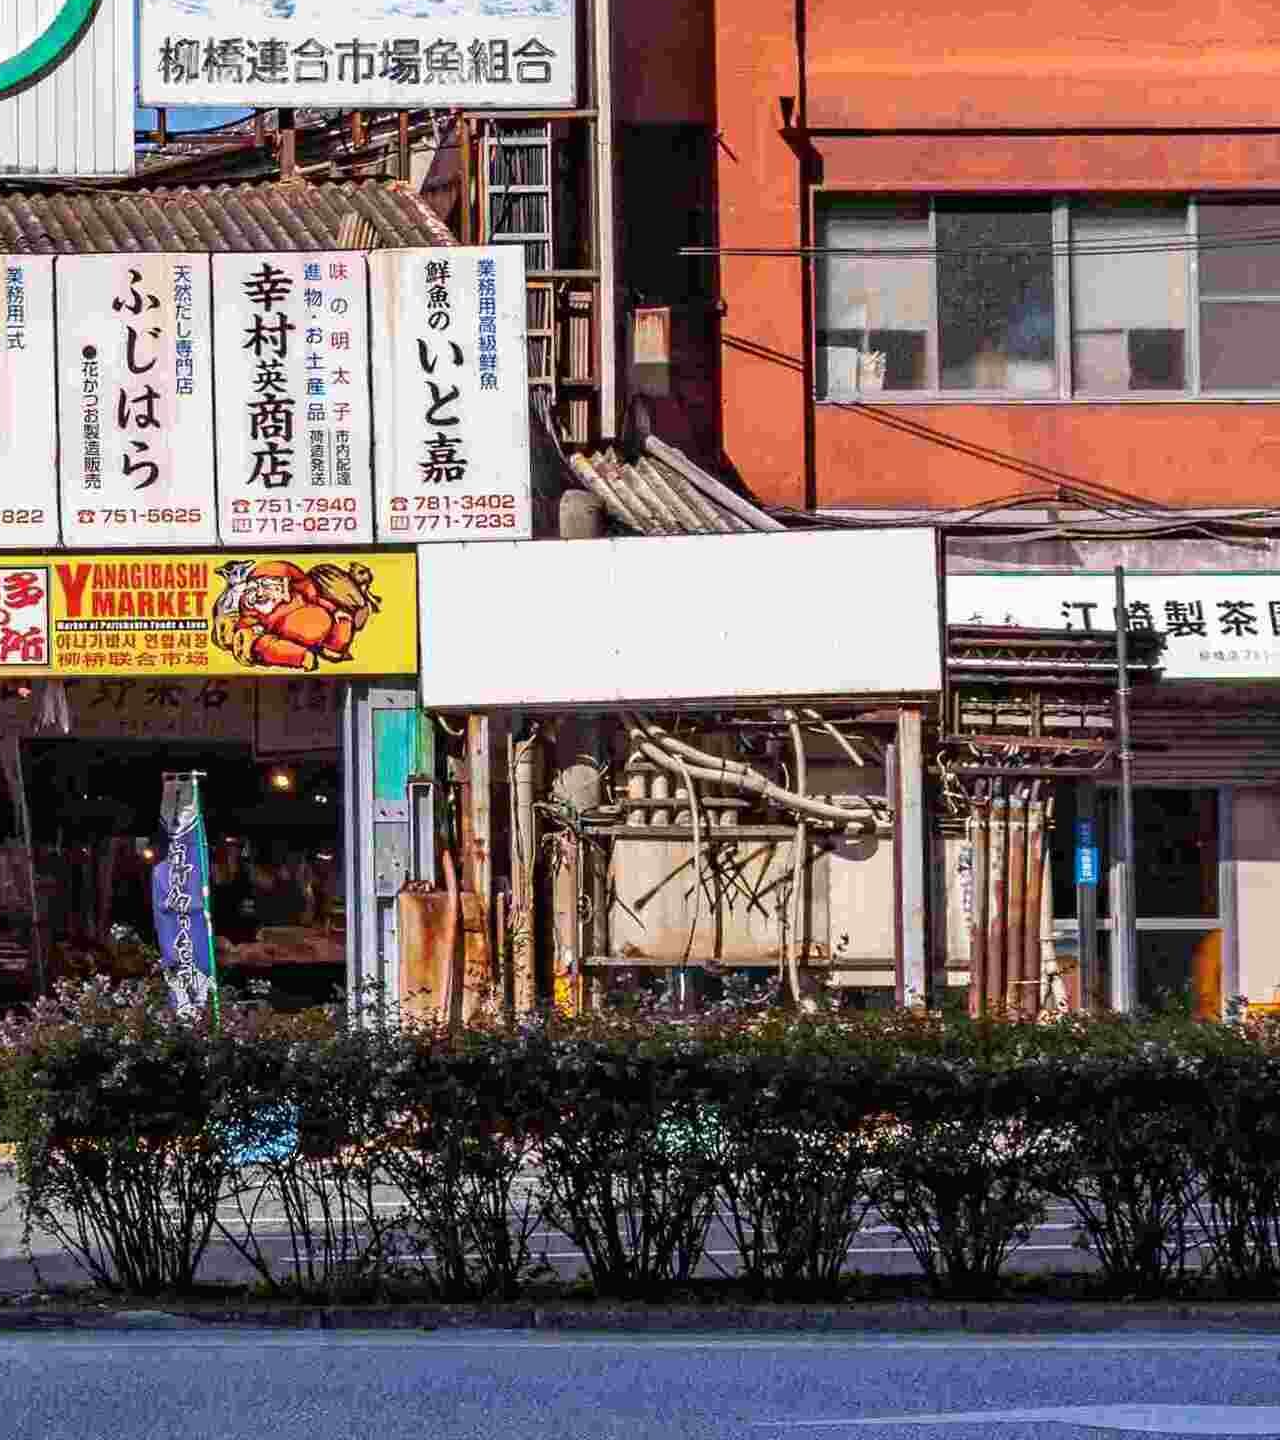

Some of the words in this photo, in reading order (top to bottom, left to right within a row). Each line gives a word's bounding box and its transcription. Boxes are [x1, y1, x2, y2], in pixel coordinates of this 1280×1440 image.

[157, 36, 557, 85] 柳橋連合市場魚組合
[5, 268, 26, 350] 業務用一式
[175, 265, 194, 395] 天然だし専門店
[477, 258, 498, 391] 業務用高級鮮魚
[329, 263, 352, 422] 味の明太子
[112, 269, 162, 490] ふじはら
[241, 263, 296, 489] 幸村英商店
[82, 361, 101, 490] 花かつお製造販売
[100, 508, 201, 524] 751-5625
[255, 516, 357, 532] 712-0270
[412, 495, 516, 509] 781-3402
[413, 514, 516, 529] 771-7233
[56, 563, 208, 617] YANAGIBASHI
[92, 592, 208, 617] MARKET
[1061, 600, 1280, 637] 江崎製茶
